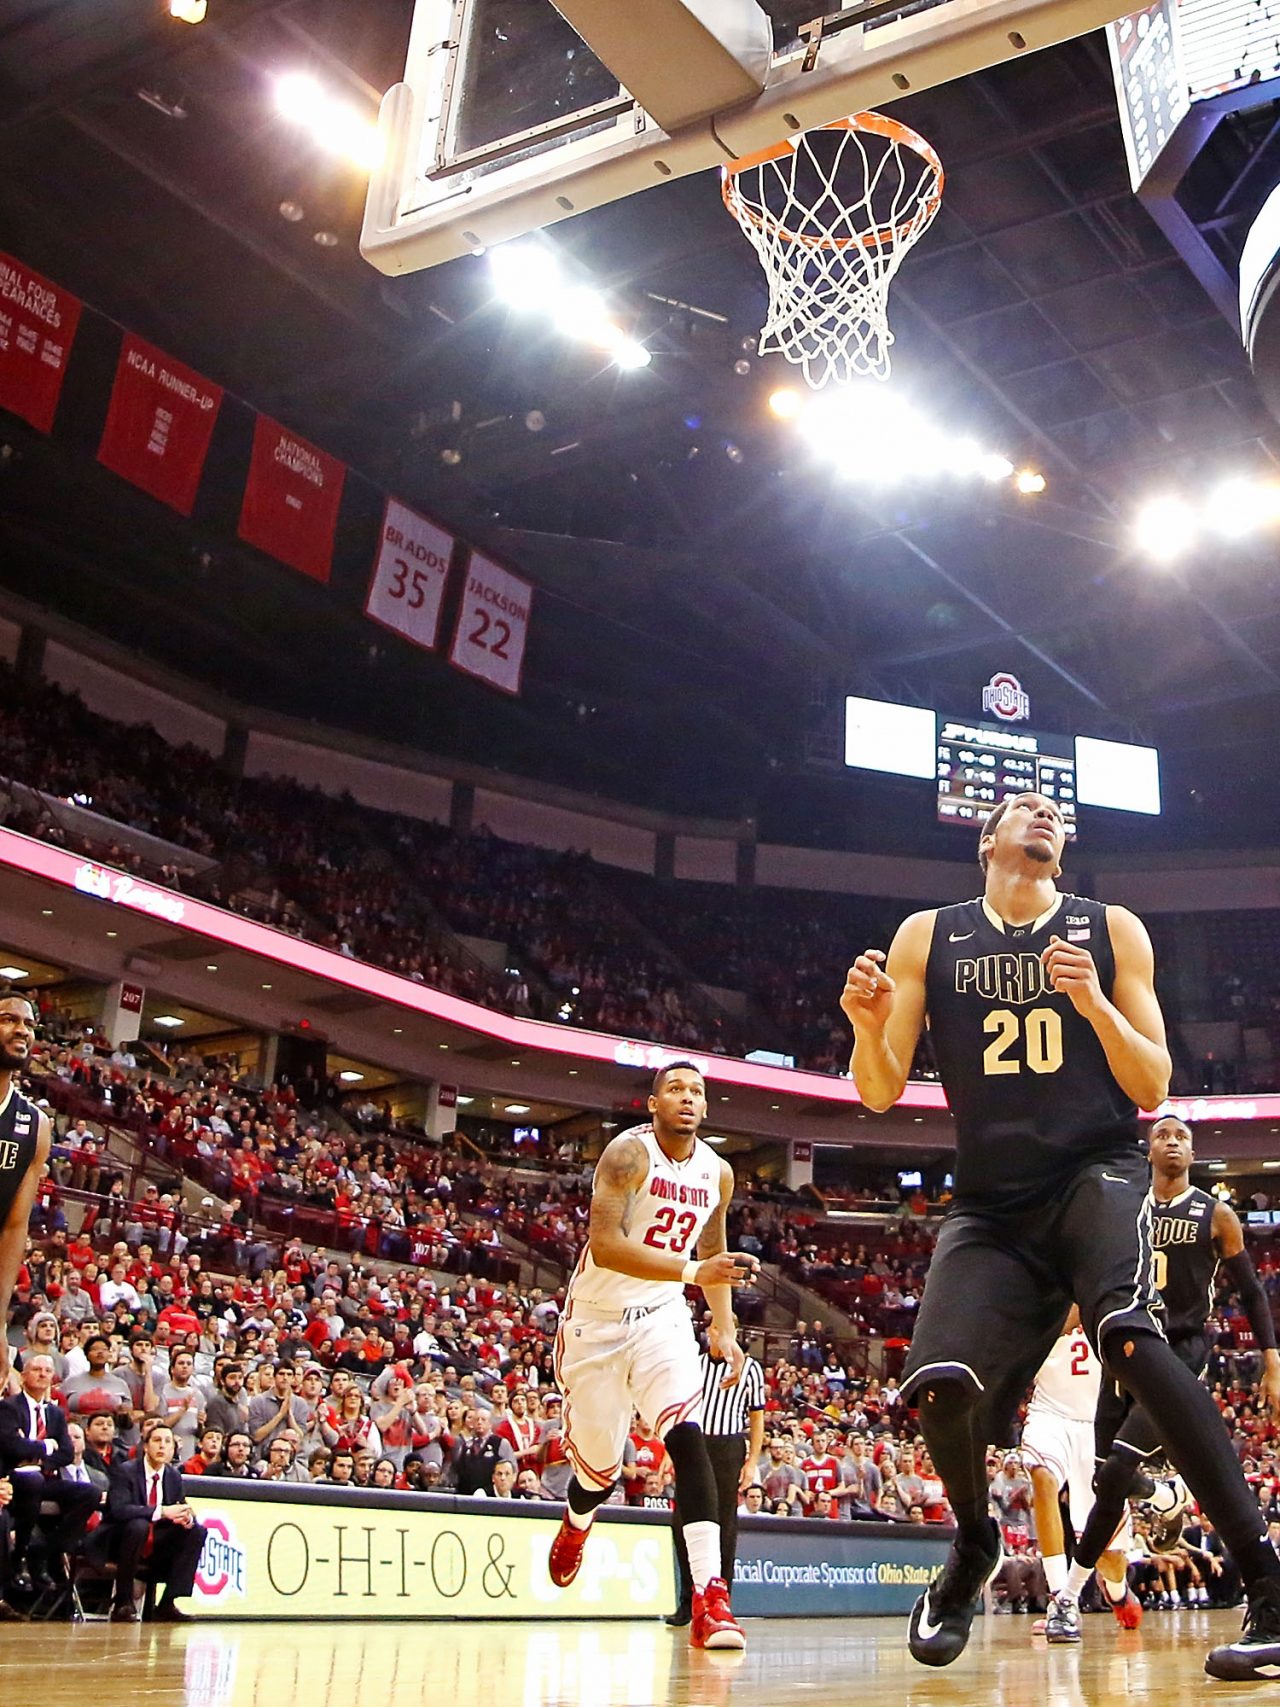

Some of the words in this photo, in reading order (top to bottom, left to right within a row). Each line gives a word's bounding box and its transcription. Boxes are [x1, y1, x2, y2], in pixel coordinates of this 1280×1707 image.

[27, 280, 57, 309] FOUR
[127, 350, 156, 378] NCAA
[158, 368, 215, 410] RUNNER-UP
[279, 435, 322, 468] NATIONAL
[385, 525, 446, 574] BRADDS
[388, 558, 428, 609] 35
[468, 578, 526, 621] JACKSON
[468, 608, 511, 660] 22
[122, 990, 141, 1004] 207
[983, 1008, 1064, 1075] 20
[650, 1176, 677, 1201] OHIO
[679, 1185, 709, 1208] STATE
[643, 1207, 697, 1253] 23
[1151, 1217, 1199, 1248] RDUE
[414, 1242, 430, 1256] 107
[1070, 1341, 1089, 1376] 2
[643, 1496, 669, 1509] POSS
[815, 1479, 824, 1492] 4
[267, 1522, 467, 1598] O-H-I-O
[482, 1532, 518, 1599] &
[733, 1558, 762, 1583] ficial
[763, 1561, 820, 1587] Corporate
[821, 1562, 866, 1588] Sponsor
[866, 1562, 878, 1583] of
[878, 1563, 902, 1585] Ohio
[903, 1565, 929, 1584] State
